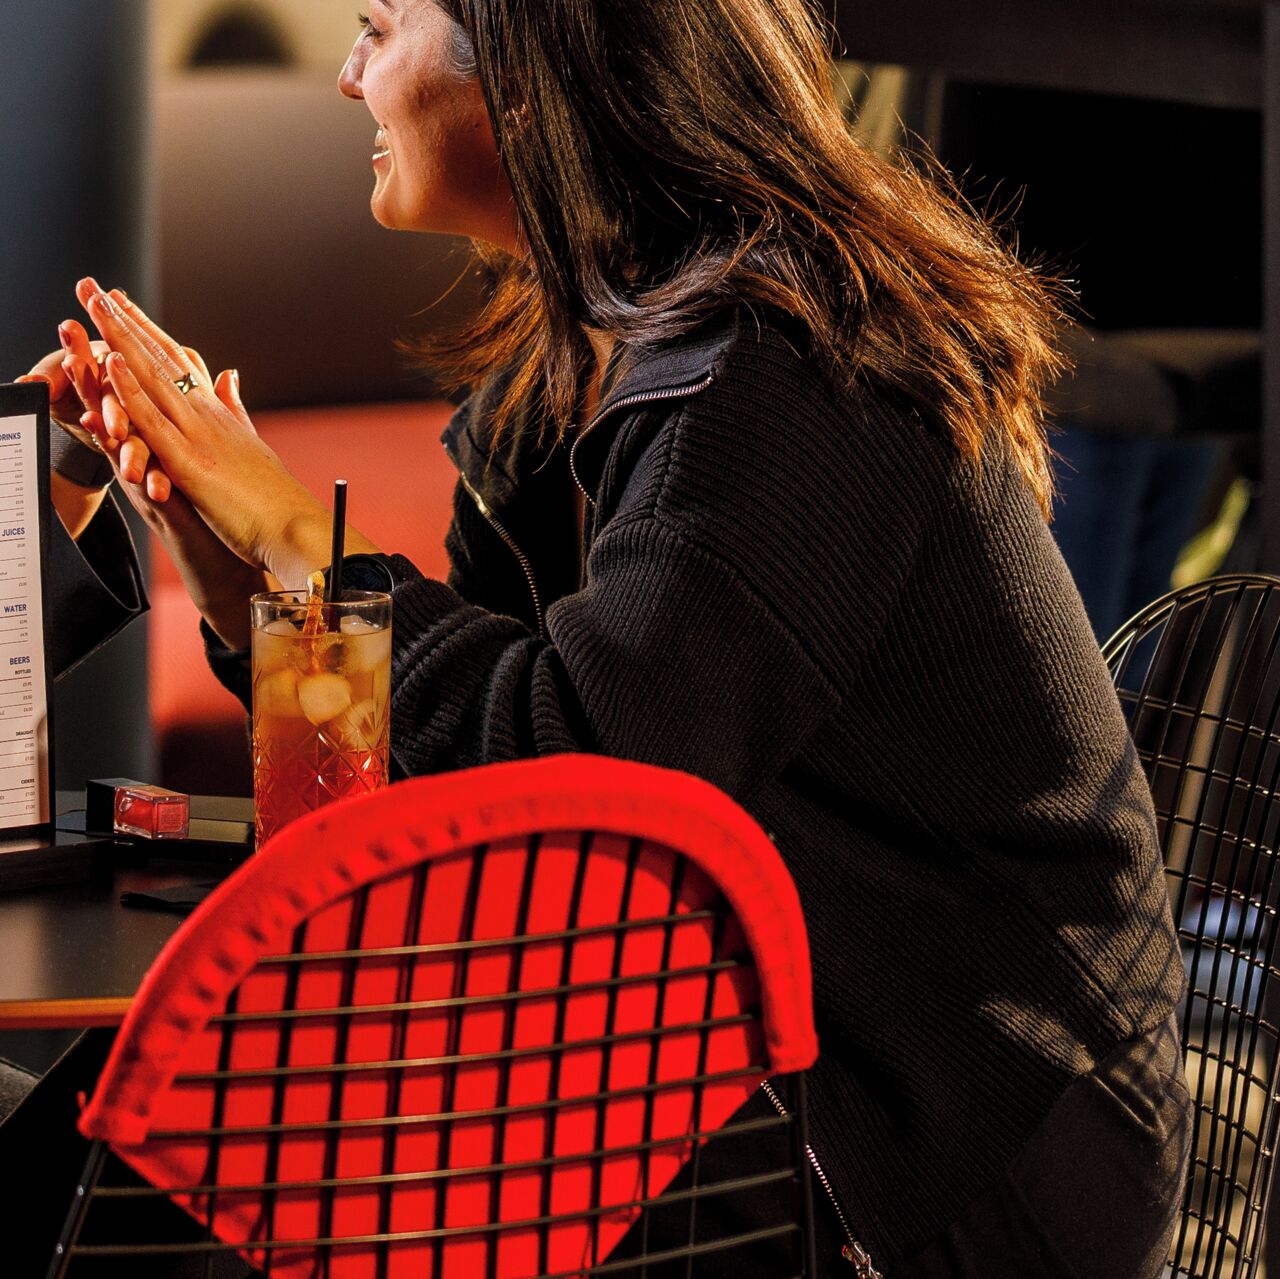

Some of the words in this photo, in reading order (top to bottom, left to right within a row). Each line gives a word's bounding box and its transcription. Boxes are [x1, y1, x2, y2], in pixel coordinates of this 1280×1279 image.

[2, 527, 25, 537] JUICES
[4, 604, 27, 613] WATER
[10, 656, 30, 665] BEERS
